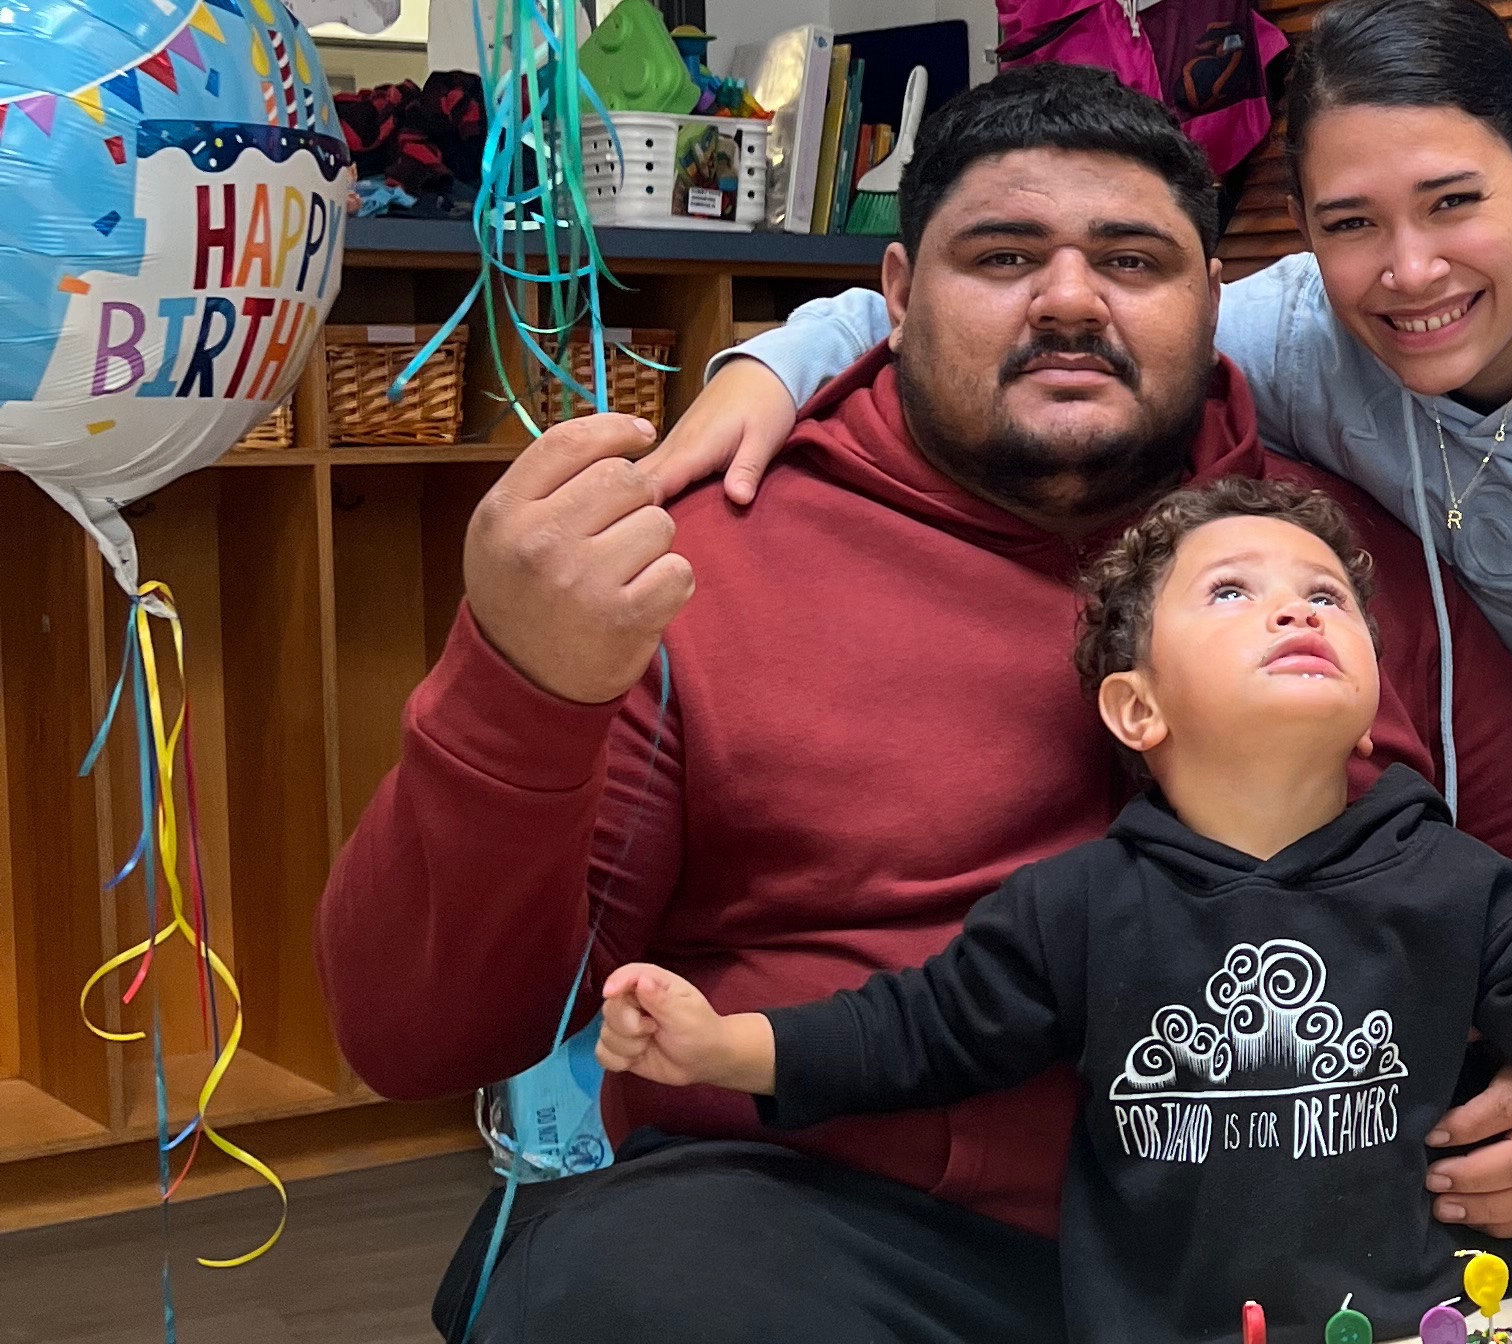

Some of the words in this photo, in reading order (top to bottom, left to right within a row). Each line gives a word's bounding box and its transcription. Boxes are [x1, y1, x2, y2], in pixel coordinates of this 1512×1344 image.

[193, 183, 342, 299] HAPPY
[1224, 1113, 1241, 1150] IS
[1248, 1111, 1280, 1149] FOR
[1293, 1083, 1399, 1160] DREAMERS
